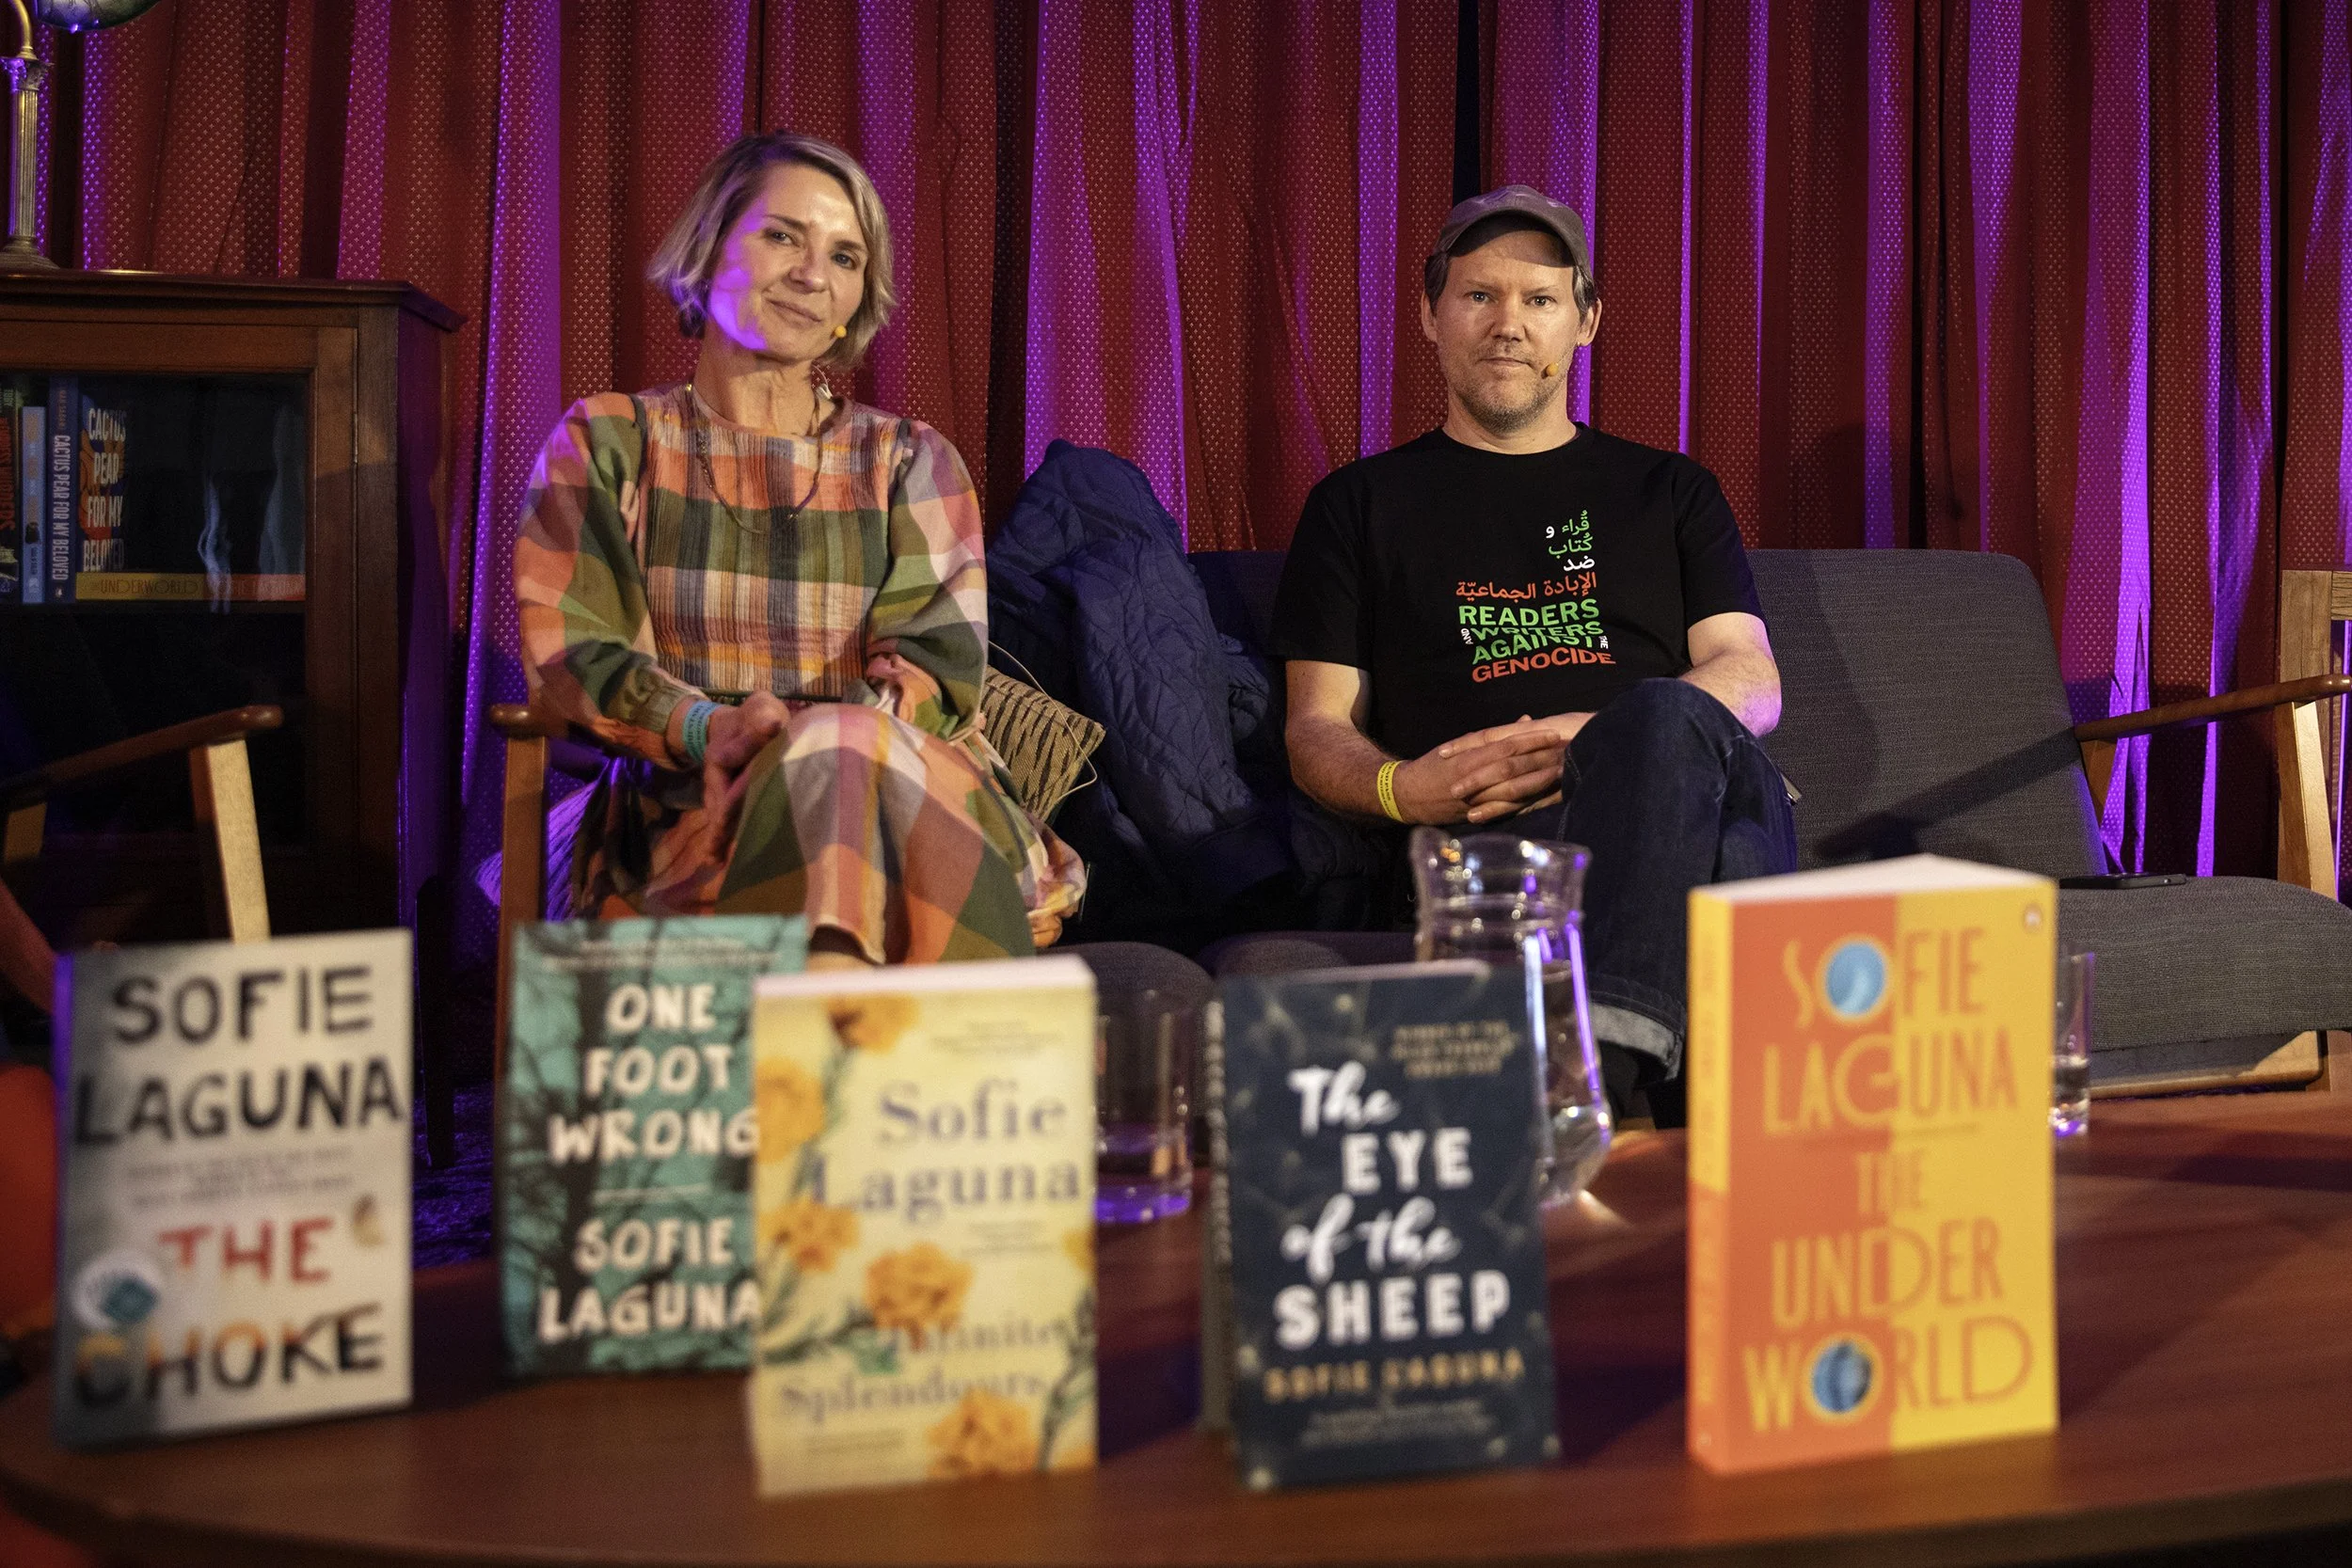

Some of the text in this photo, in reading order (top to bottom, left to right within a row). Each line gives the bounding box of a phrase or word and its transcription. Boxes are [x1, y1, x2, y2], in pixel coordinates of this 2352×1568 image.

[87, 407, 127, 441] CACTUS
[52, 435, 71, 472] CACTUS
[93, 452, 119, 485] PEAR
[52, 474, 71, 499] PEAR
[52, 501, 71, 519] FOR
[87, 496, 123, 528] FOR MY
[52, 522, 70, 536] MY
[83, 538, 125, 573] BELOVED
[1546, 525, 1555, 538] و
[52, 539, 70, 580] BELOVED
[101, 578, 199, 596] UNDERWORLD
[1544, 572, 1597, 596] الإبادة
[1563, 555, 1595, 571] ضد
[1459, 598, 1599, 626] READERS
[1460, 621, 1603, 645] AND WRITERS
[1472, 647, 1616, 683] GENOCIDE
[1599, 635, 1609, 650] THE
[112, 964, 373, 1045] SOFIE
[1783, 926, 1986, 1029] SOFIE
[606, 983, 716, 1034] ONE
[584, 1043, 733, 1098] FOOT
[1287, 1059, 1403, 1135] The
[1762, 1025, 2018, 1137] LAGUNA
[74, 1053, 404, 1147] LAGUNA
[879, 1076, 1068, 1145] Sofie
[548, 1108, 761, 1164] WRONG
[1342, 1127, 1474, 1196] EYE
[805, 1148, 1081, 1224] Laguna
[1856, 1148, 1928, 1215] THE
[158, 1216, 333, 1284] THE
[573, 1217, 736, 1274] SOFIE
[1279, 1193, 1463, 1284] of the
[1772, 1216, 2005, 1331] UNDER
[537, 1279, 763, 1343] LAGUNA
[1273, 1270, 1511, 1350] SHEEP
[72, 1302, 383, 1406] CHOKE
[1742, 1315, 2035, 1433] WORLD
